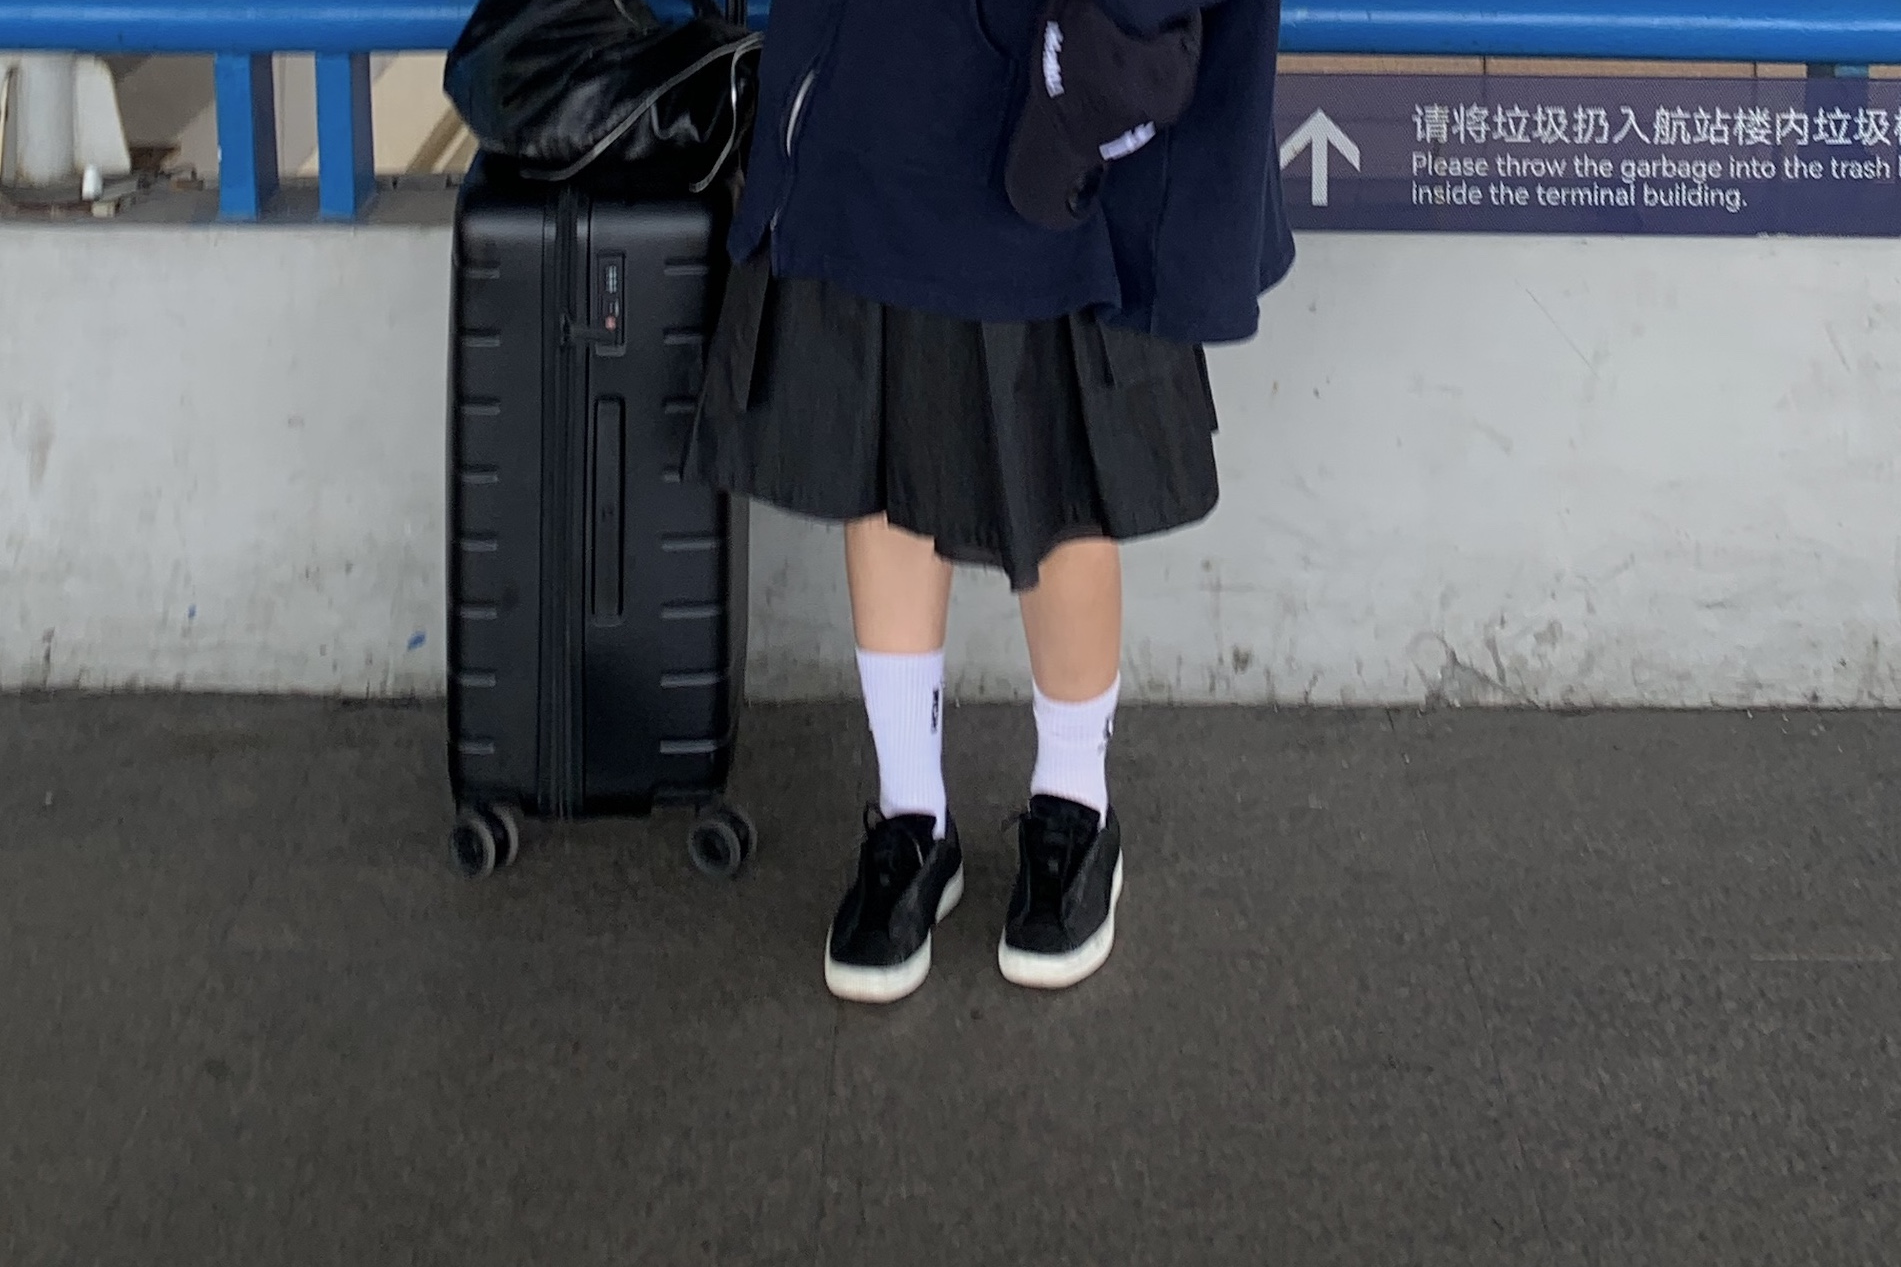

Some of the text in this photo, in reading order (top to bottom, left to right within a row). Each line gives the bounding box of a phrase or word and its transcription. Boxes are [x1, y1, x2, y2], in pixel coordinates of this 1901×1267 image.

[1412, 102, 1901, 146] 请将垃圾扔入航站楼内垃圾
[1412, 150, 1489, 177] Please
[1495, 152, 1567, 177] throw
[1574, 152, 1614, 178] the
[1620, 153, 1723, 184] garbage
[1729, 155, 1776, 179] into
[1783, 155, 1824, 179] the
[1830, 155, 1891, 180] trash
[1412, 179, 1748, 213] inside the terminal building.
